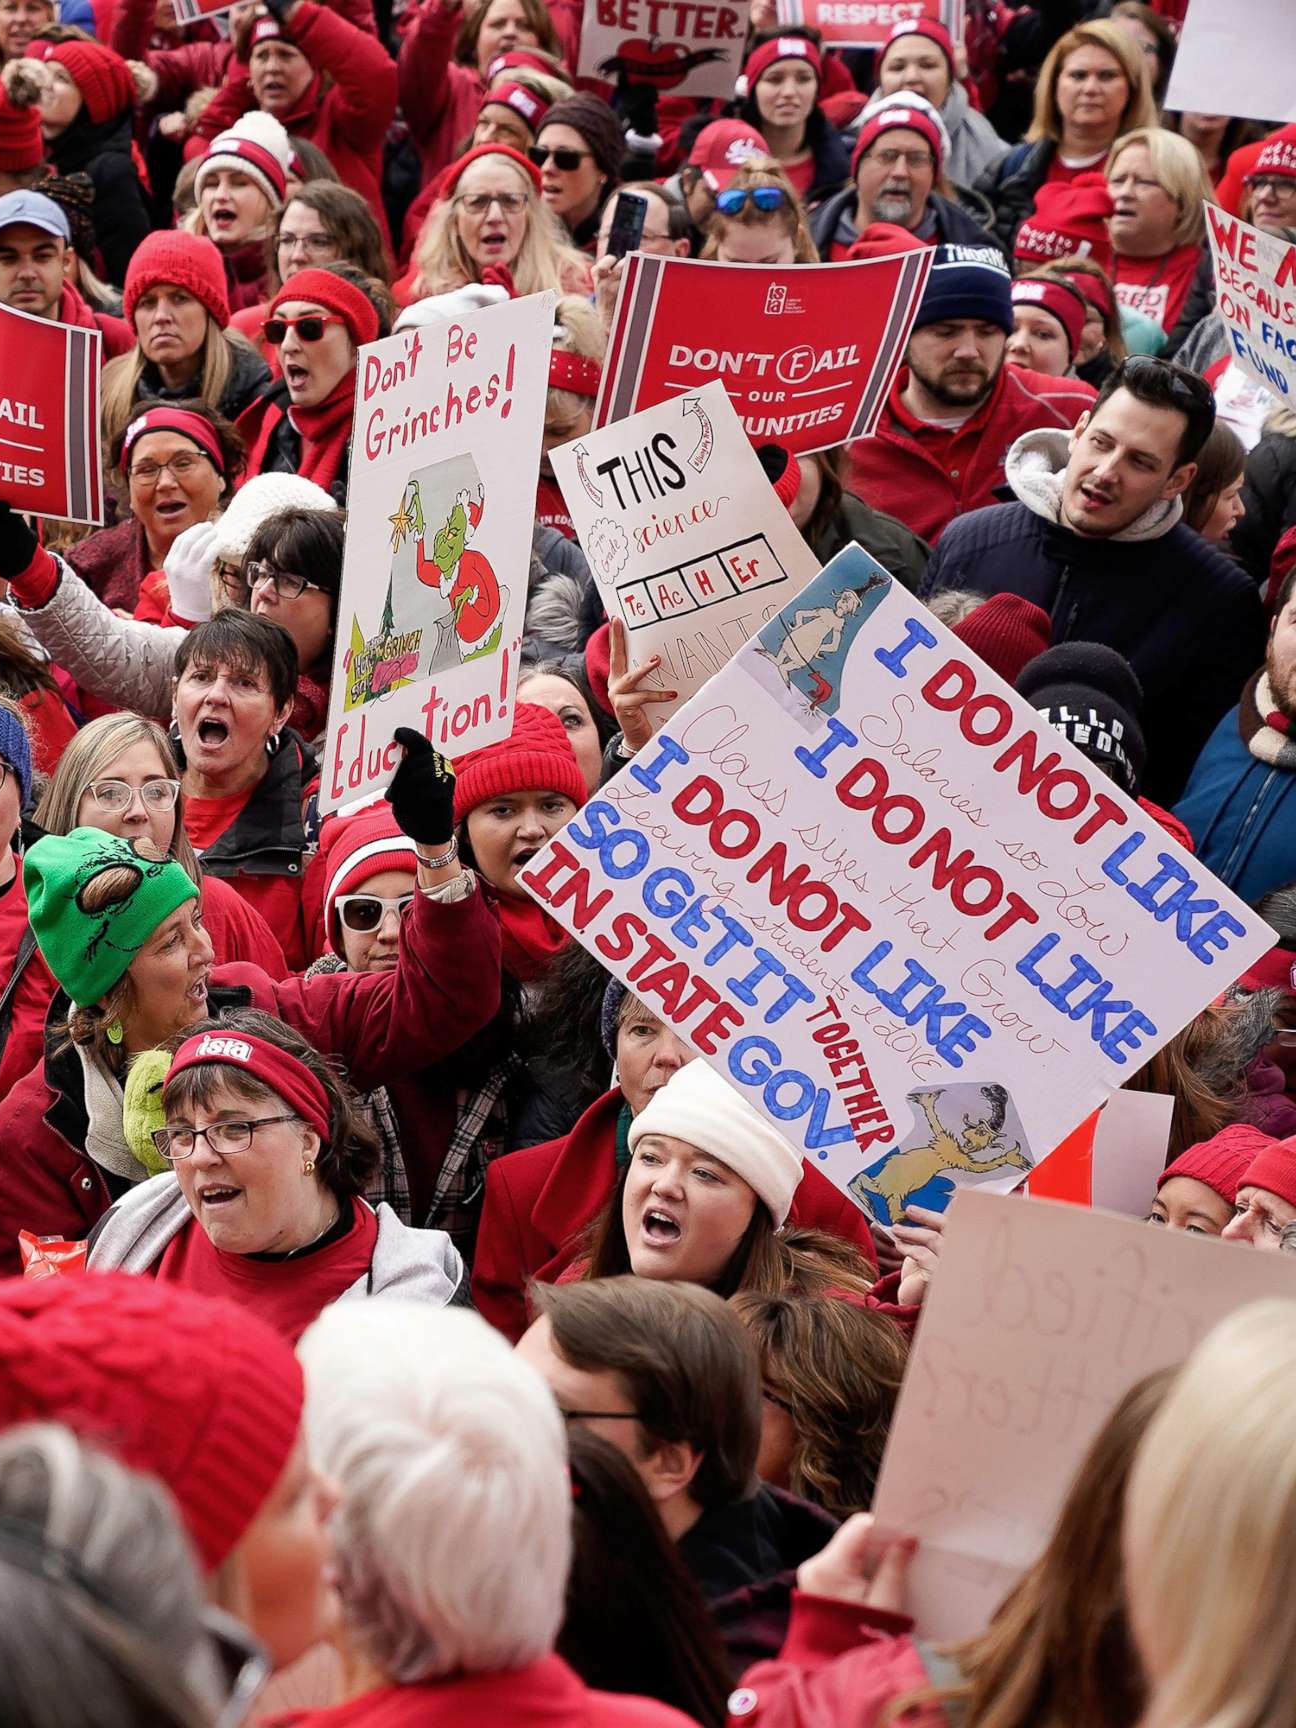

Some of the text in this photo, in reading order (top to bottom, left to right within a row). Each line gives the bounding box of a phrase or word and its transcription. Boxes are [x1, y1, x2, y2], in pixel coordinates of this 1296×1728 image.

[596, 0, 745, 39] BETTER.
[817, 2, 926, 25] RESPECT
[1207, 206, 1259, 273] WE
[1220, 292, 1251, 332] ON
[364, 323, 478, 402] Don't Be
[669, 344, 860, 382] DON'T FAIL
[748, 390, 786, 402] OUR
[1230, 327, 1289, 395] FUND
[365, 343, 516, 461] Grinches!
[597, 432, 686, 510] THIS
[633, 496, 730, 553] science
[859, 693, 990, 828] Salaries
[994, 838, 1048, 871] so
[1037, 866, 1130, 957] Low
[873, 617, 939, 679] I
[921, 658, 1014, 748] DO
[993, 730, 1129, 845] NOT
[1101, 830, 1247, 966] LIKE
[604, 783, 744, 912] Leaving
[738, 911, 850, 1002] students
[629, 734, 993, 1069] I DO NOT LIKE
[680, 704, 1072, 1058] Class sizes that Grow
[793, 716, 1160, 1065] I DO NOT LIKE
[524, 840, 856, 1161] IN STATE GOV.
[567, 800, 896, 1154] SO GET IT TOGETHER
[196, 1034, 254, 1061] ista
